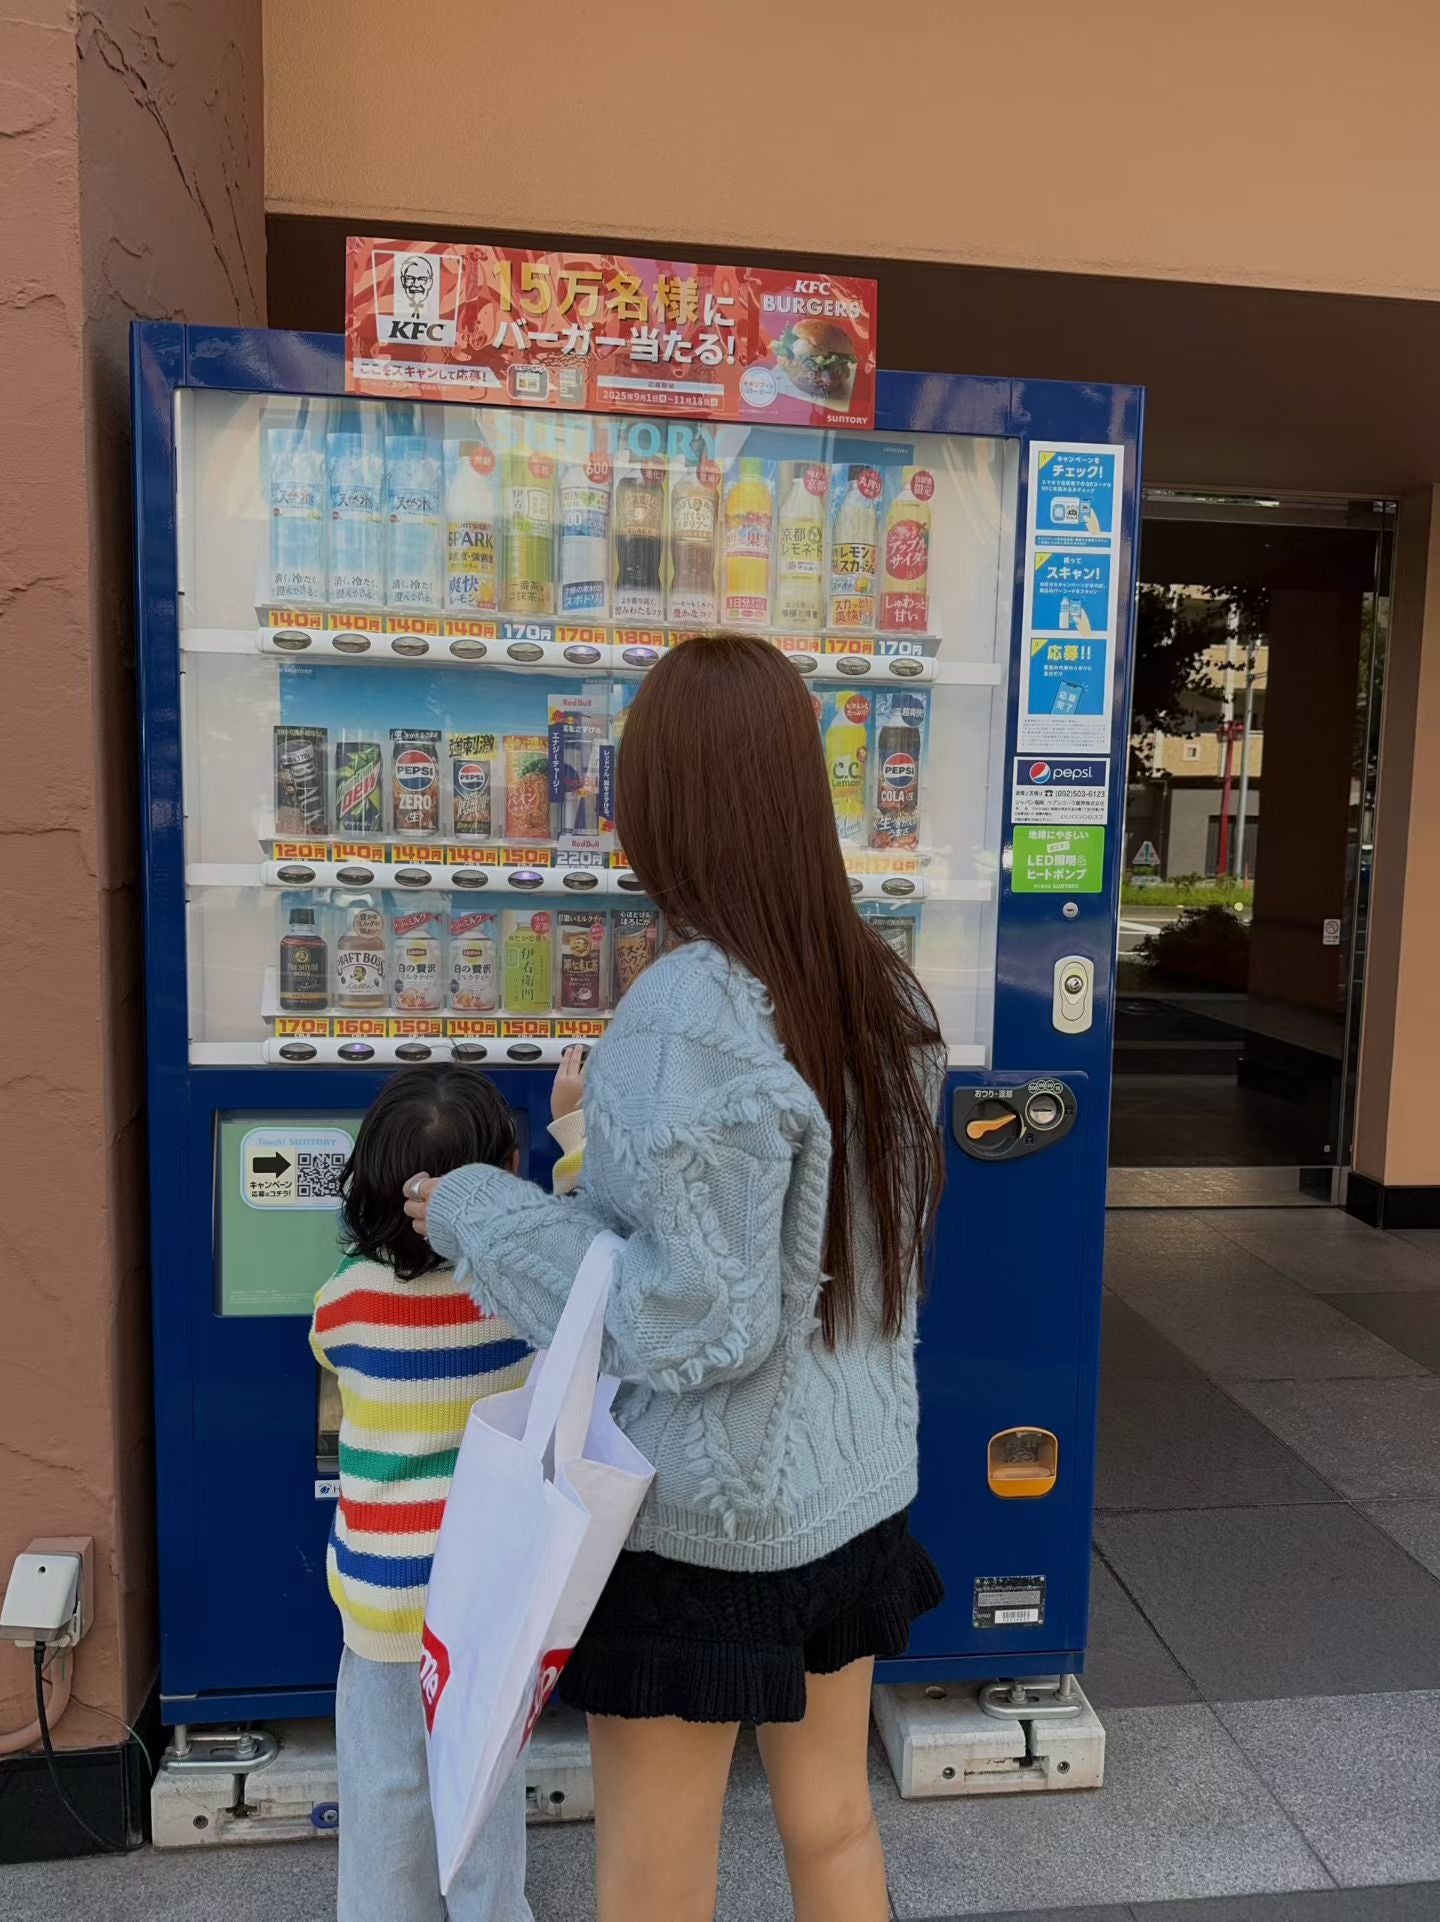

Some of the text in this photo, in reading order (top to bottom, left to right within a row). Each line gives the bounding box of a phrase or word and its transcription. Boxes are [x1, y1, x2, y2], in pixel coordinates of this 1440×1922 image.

[495, 261, 735, 328] 15万名様に
[794, 279, 832, 297] KFC
[763, 293, 862, 320] BURGERS
[388, 320, 445, 343] KFC
[493, 318, 735, 367] バーガー当たる!
[827, 415, 869, 426] SUNTORY
[1052, 464, 1103, 479] チェック!
[782, 528, 805, 542] 京都
[782, 543, 823, 559] レモネード
[840, 546, 870, 559] レモン
[890, 553, 929, 569] サイダー
[1046, 566, 1101, 581] スキャン!
[271, 612, 321, 628] 140円
[330, 615, 380, 631] 140円
[895, 610, 919, 624] 甘い
[389, 618, 439, 635] 140円
[445, 621, 494, 637] 140円
[504, 624, 552, 640] 170円
[559, 627, 605, 643] 170円
[616, 629, 663, 645] 180円
[828, 640, 872, 656] 170円
[878, 640, 922, 656] 170円
[563, 699, 577, 707] Red
[449, 734, 495, 758] 強刺激
[397, 766, 434, 777] PEPSI
[460, 774, 484, 782] PEPSI
[885, 766, 914, 776] PEPSI
[1052, 766, 1093, 781] pepsi
[831, 779, 861, 788] Lemon
[881, 791, 905, 803] COLA
[1055, 789, 1105, 798] (092)503-6123
[399, 793, 432, 811] ZERO
[1028, 829, 1089, 841] 地球にやさしい
[276, 844, 325, 858] 120円
[572, 840, 600, 848] Red Bull
[334, 845, 383, 860] 140円
[394, 846, 442, 861] 140円
[449, 848, 496, 862] 140円
[503, 849, 549, 863] 150円
[557, 851, 603, 865] 220円
[1027, 867, 1088, 881] ヒートポンプ
[363, 953, 385, 973] BOSS
[279, 1019, 328, 1033] 170円
[337, 1020, 384, 1034] 160円
[394, 1019, 442, 1034] 150円
[449, 1020, 496, 1034] 140円
[504, 1020, 549, 1034] 150円
[558, 1021, 603, 1034] 140円
[289, 1138, 337, 1147] SUNTORY
[249, 1180, 293, 1191] キャンペーン
